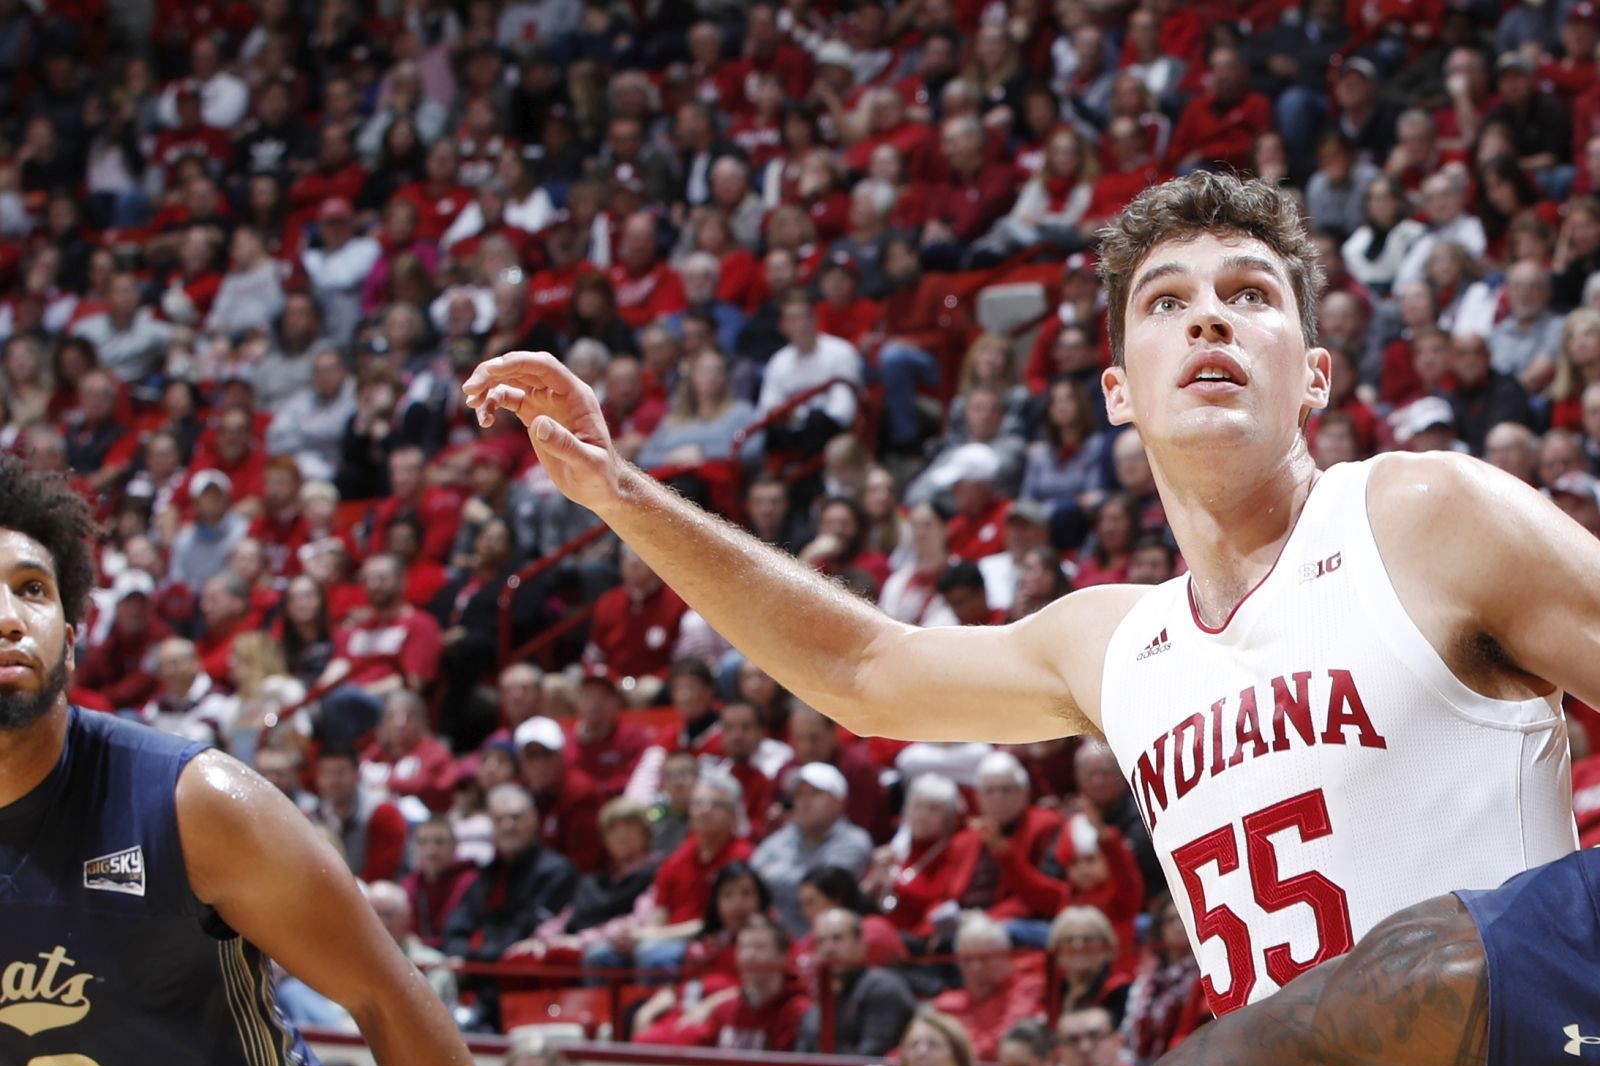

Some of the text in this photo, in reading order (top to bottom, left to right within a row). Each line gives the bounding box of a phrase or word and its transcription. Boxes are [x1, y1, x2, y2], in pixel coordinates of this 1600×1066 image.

[1136, 642, 1171, 661] adidas
[1170, 787, 1356, 1019] 55
[0, 945, 94, 1004] ats
